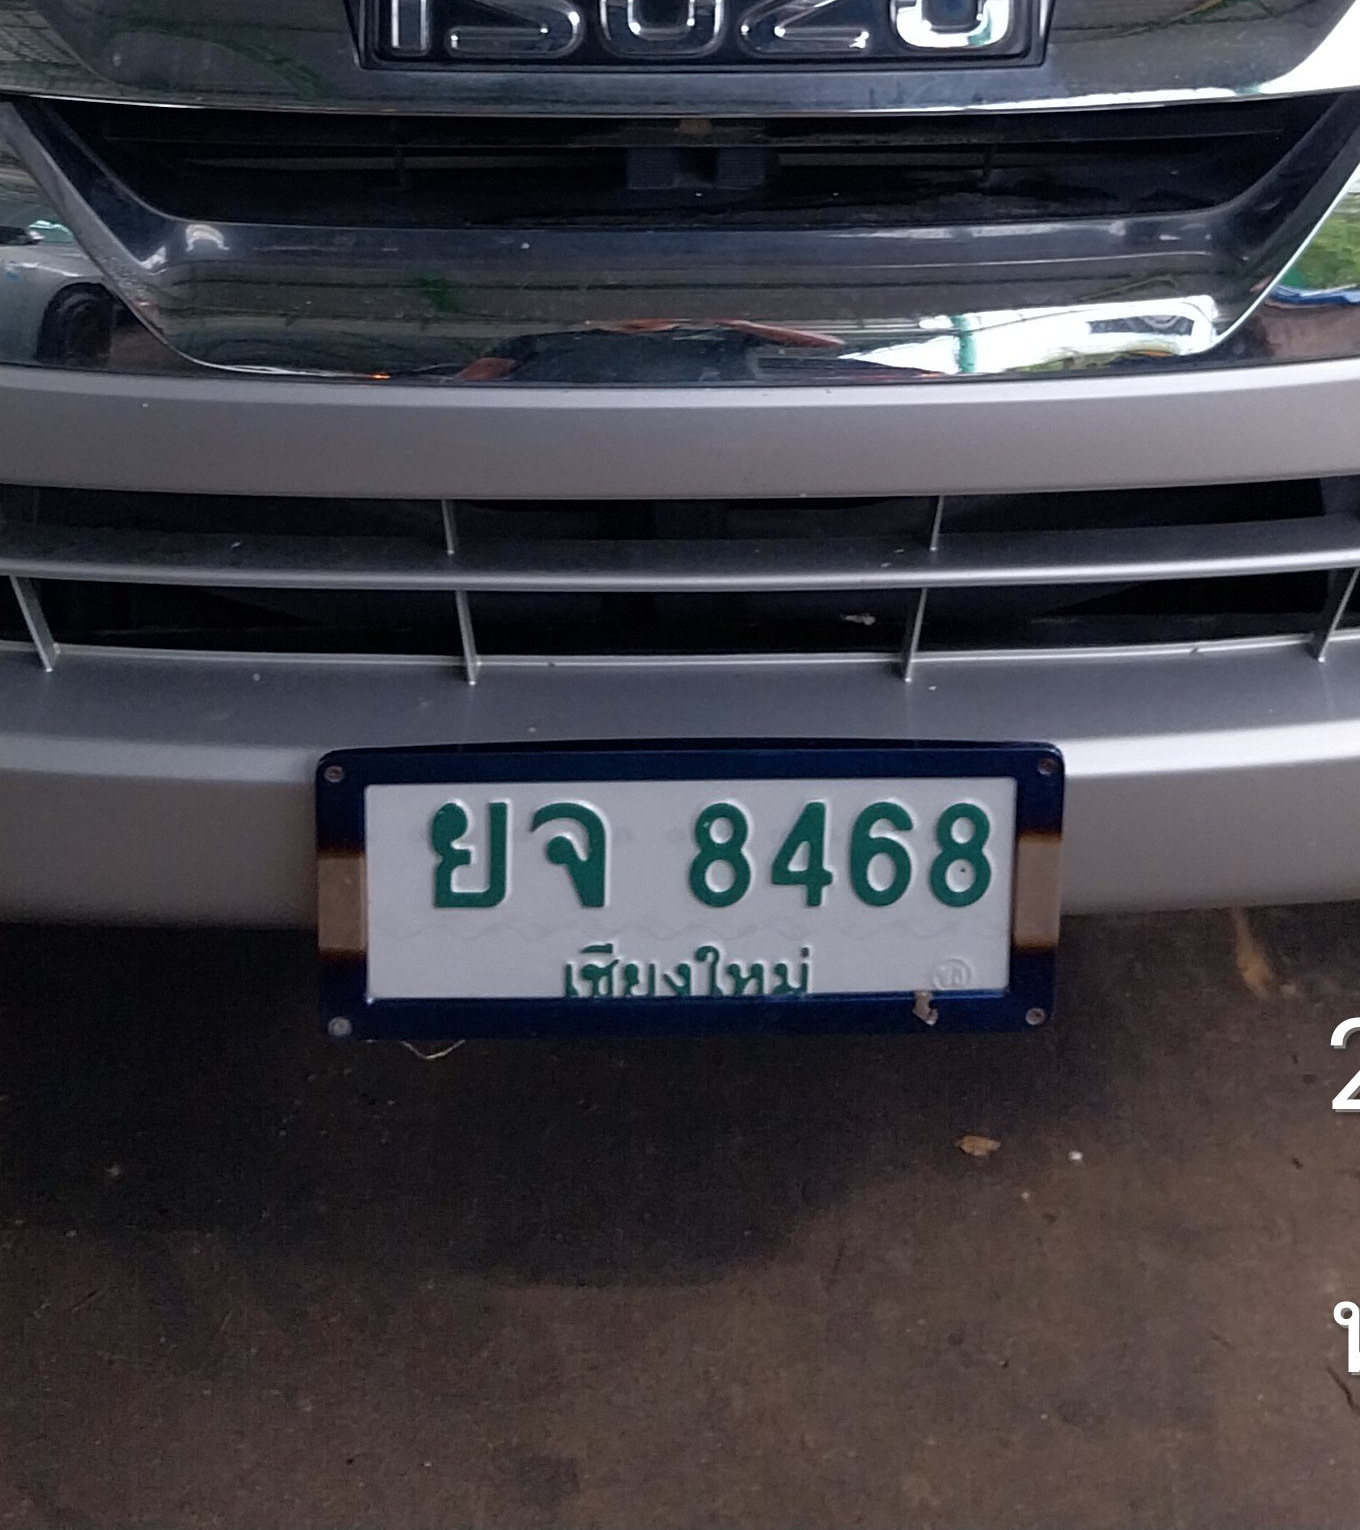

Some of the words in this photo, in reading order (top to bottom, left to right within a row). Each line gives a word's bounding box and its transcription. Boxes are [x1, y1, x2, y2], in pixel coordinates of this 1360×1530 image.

[430, 801, 608, 908] ยจ
[689, 801, 993, 907] 8468
[564, 942, 811, 998] เชียงใหม่
